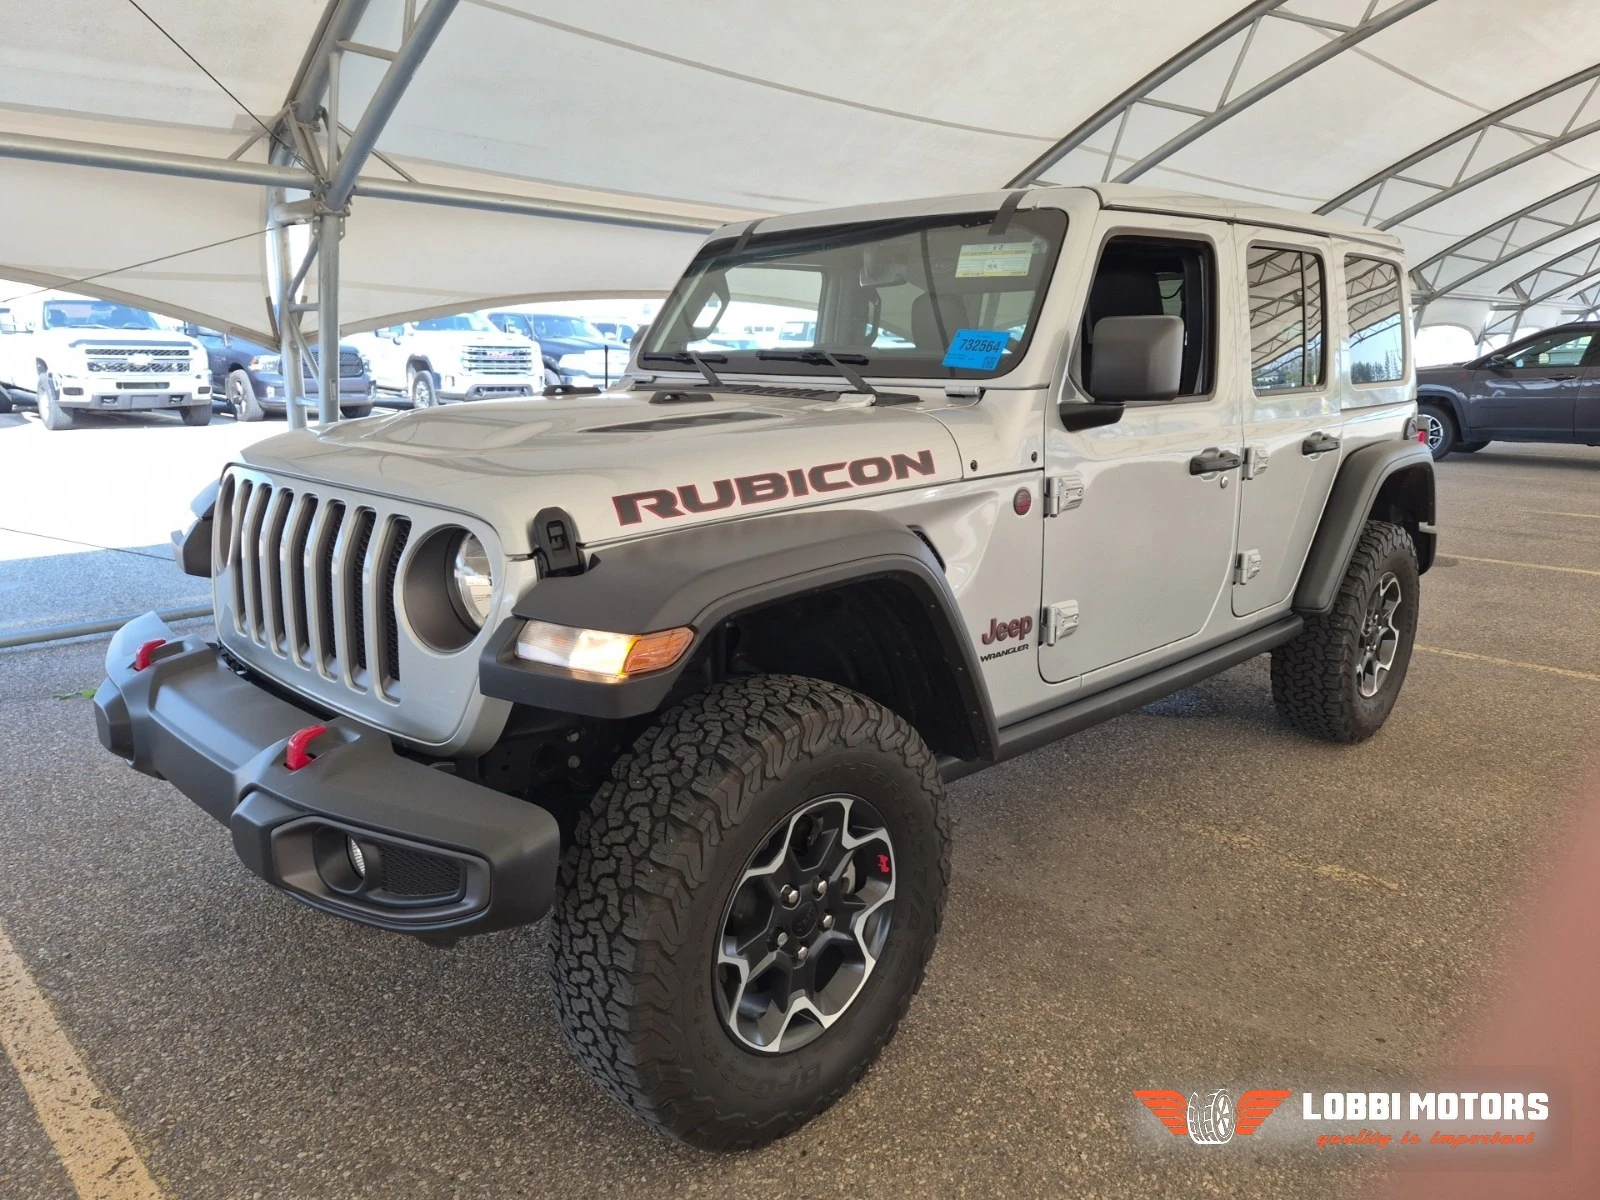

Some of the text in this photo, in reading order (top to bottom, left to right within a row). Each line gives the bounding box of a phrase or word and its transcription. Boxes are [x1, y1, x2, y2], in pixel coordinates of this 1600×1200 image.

[960, 339, 1001, 352] 732564
[611, 449, 936, 527] RUBICON
[981, 615, 1033, 645] Jeep
[980, 643, 1029, 663] WRANGLER
